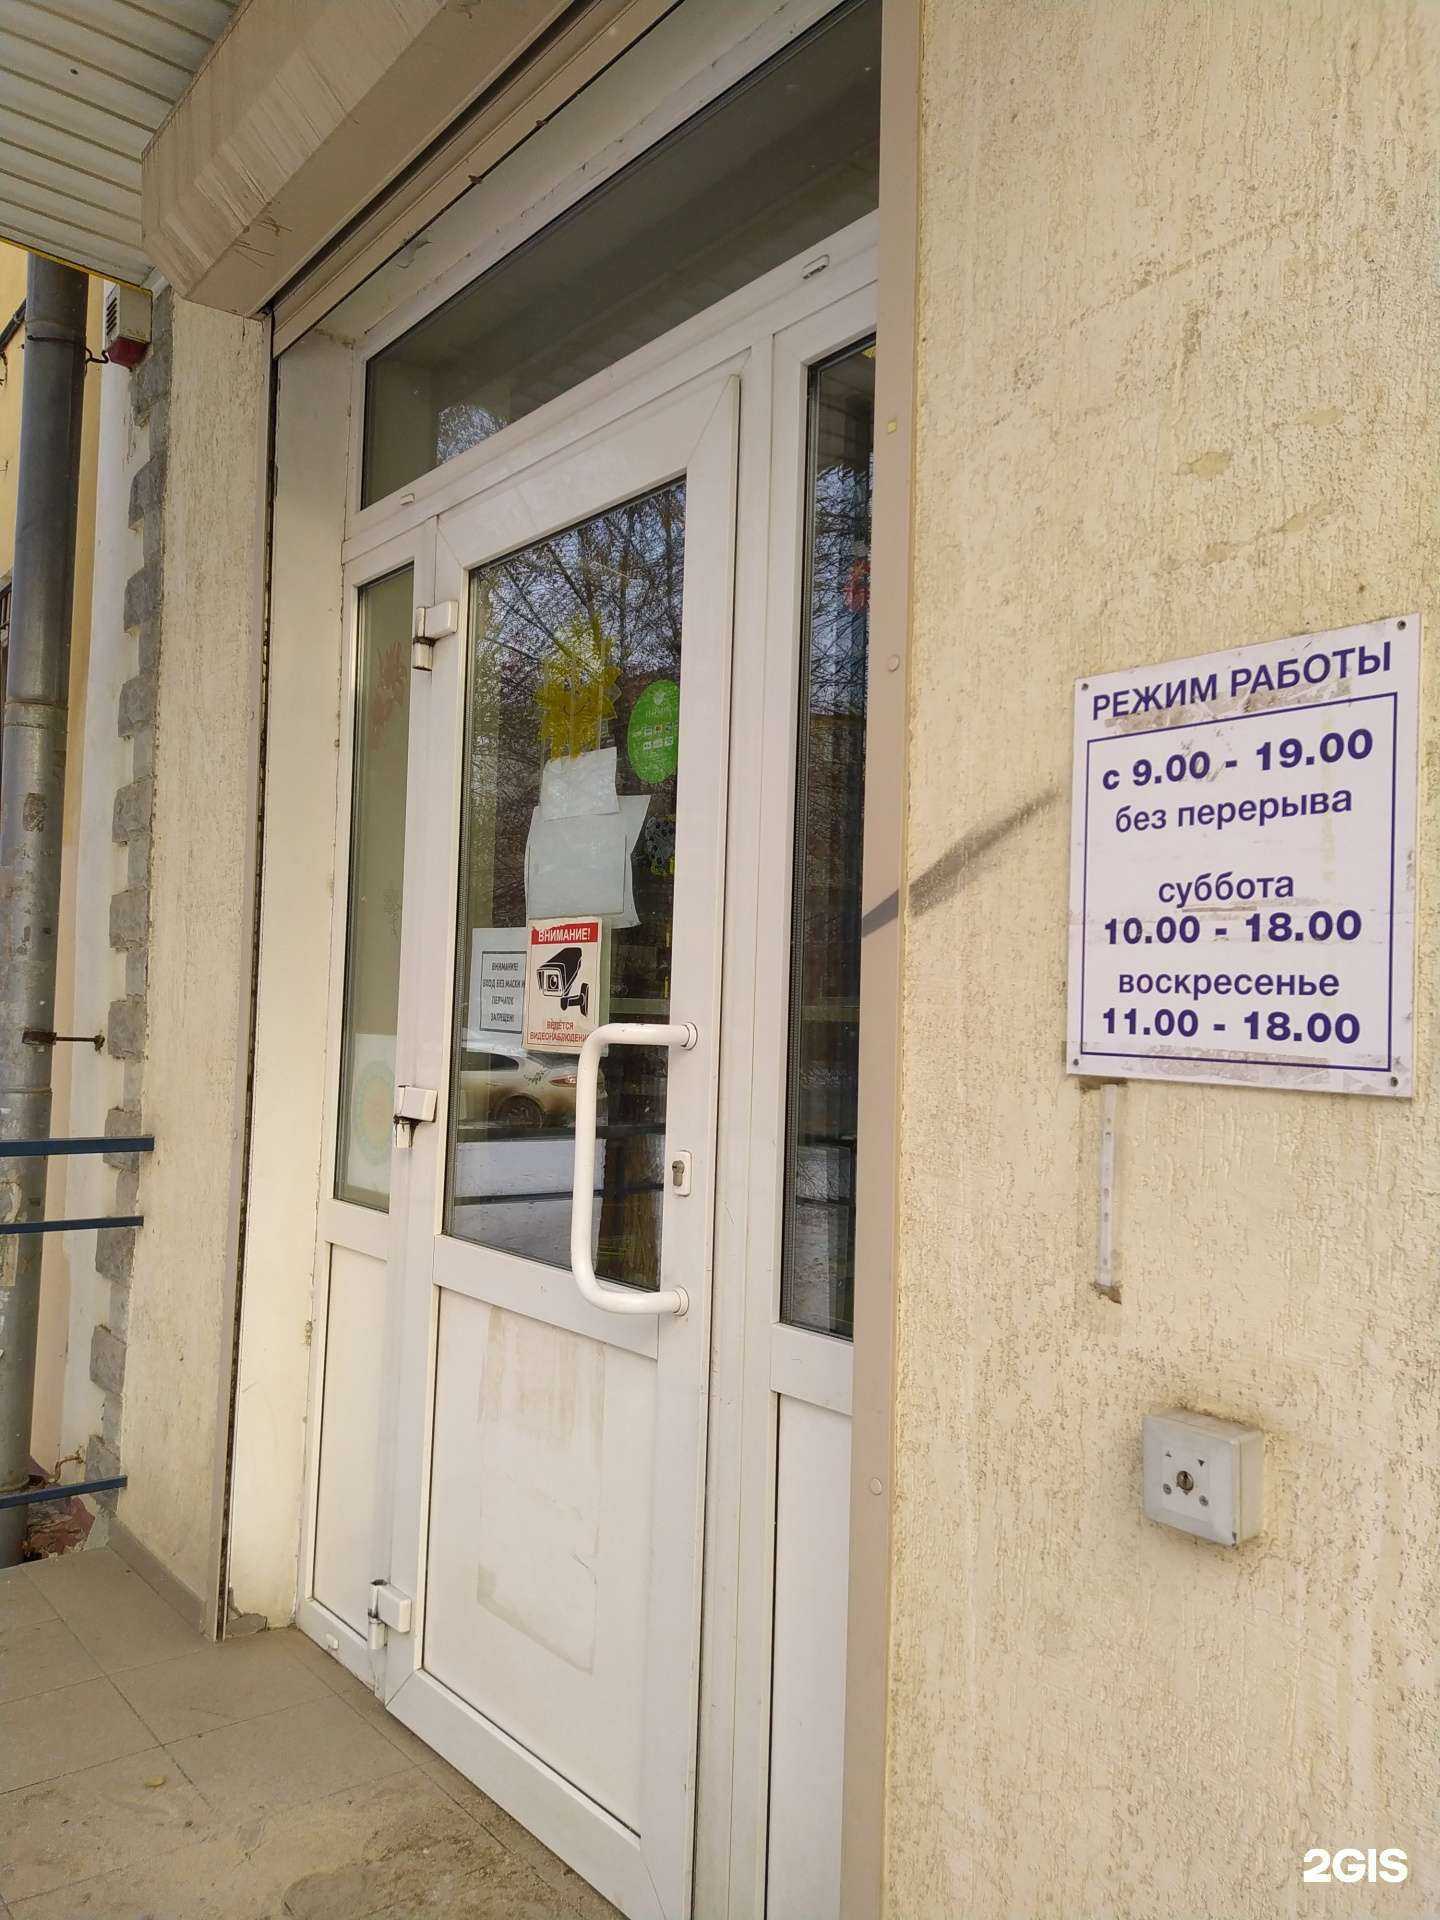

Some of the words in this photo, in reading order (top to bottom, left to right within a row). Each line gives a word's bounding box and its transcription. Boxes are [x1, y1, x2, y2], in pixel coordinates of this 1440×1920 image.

[1092, 673, 1217, 721] РЕЖИМ
[1230, 641, 1391, 697] РАБОТЫ
[1102, 769, 1120, 791] с
[1132, 751, 1211, 787] 9.00
[1256, 728, 1373, 771] 19.00
[1115, 805, 1167, 833] без
[1178, 789, 1352, 831] перерыва
[1158, 871, 1294, 908] суббота
[538, 928, 591, 942] ВНИМАНИЕ!
[1104, 915, 1201, 945] 10.00
[1245, 909, 1362, 943] 18.00
[1119, 973, 1340, 1001] воскресенье
[1103, 1007, 1199, 1038] 11.00
[1243, 1011, 1361, 1045] 18.00
